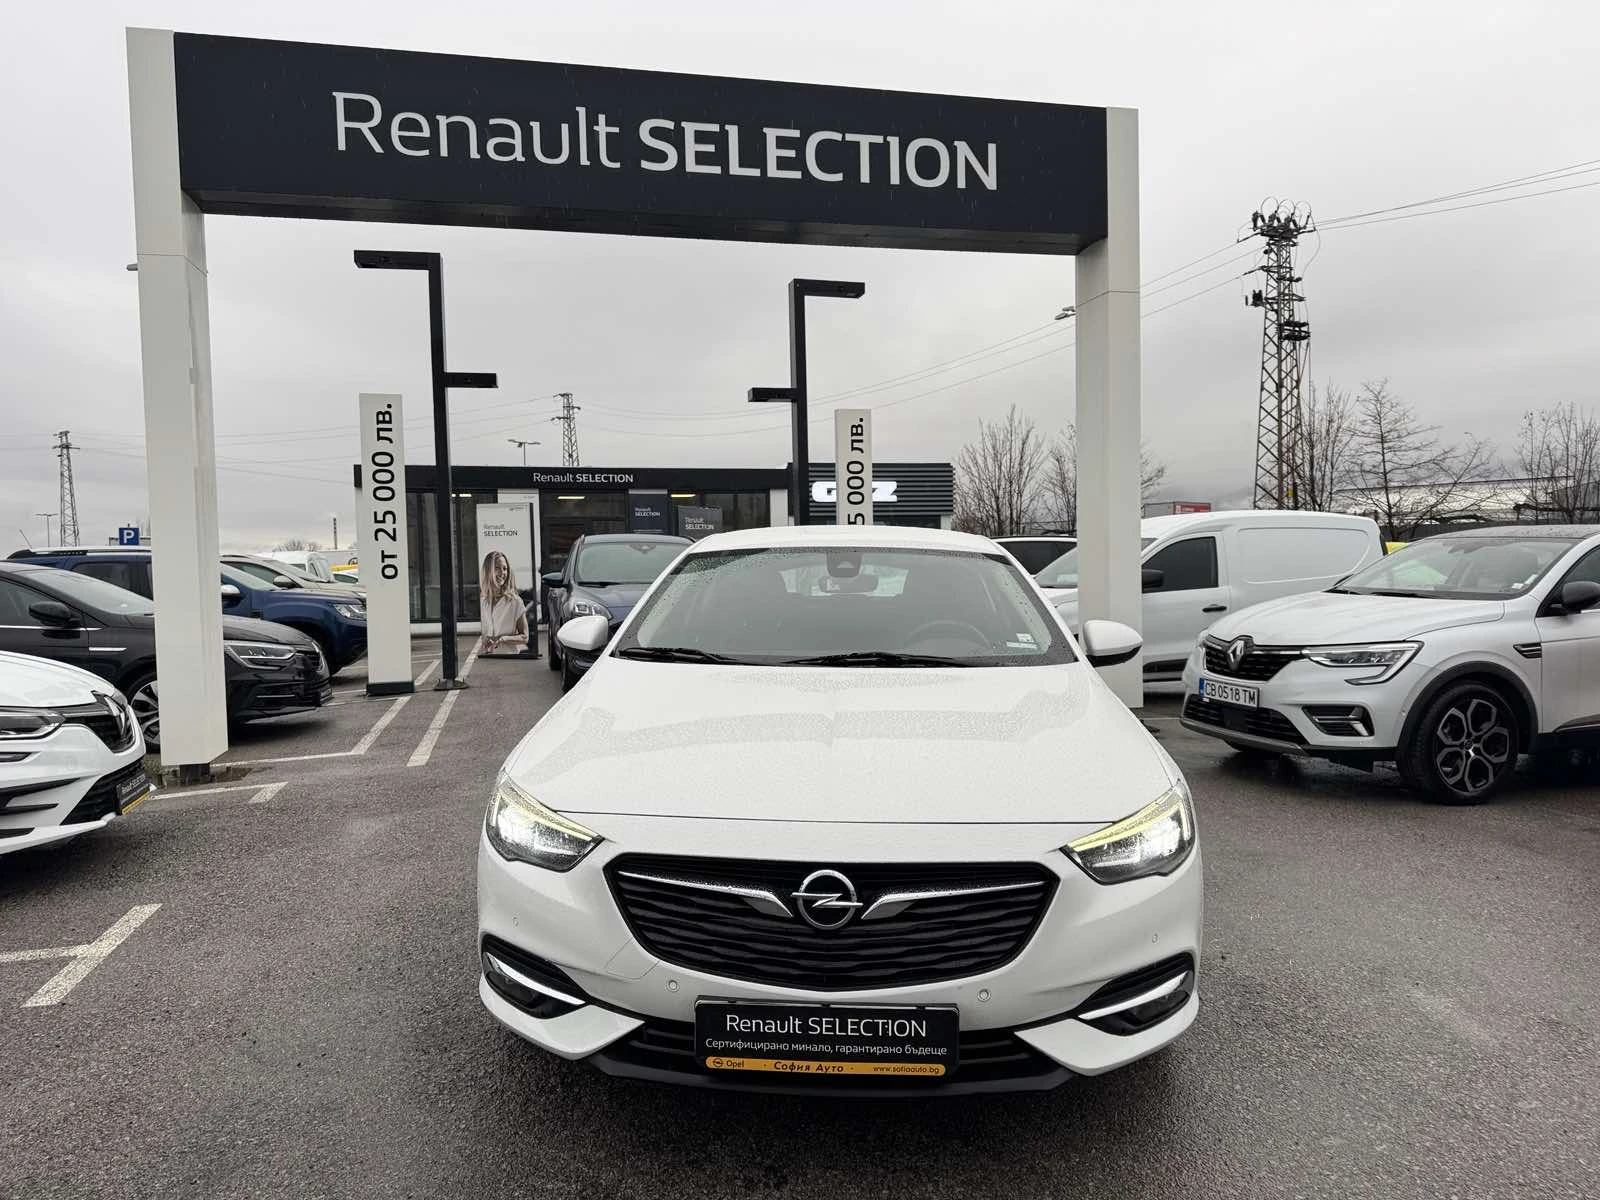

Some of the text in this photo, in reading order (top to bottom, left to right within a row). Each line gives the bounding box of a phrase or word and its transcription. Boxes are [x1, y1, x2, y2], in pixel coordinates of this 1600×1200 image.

[332, 91, 999, 191] Renault SELECTION
[850, 417, 864, 454] лв.
[533, 472, 634, 483] Renault SELECTION
[846, 460, 865, 505] 000
[371, 403, 398, 580] от 25 000 лв.
[123, 530, 135, 544] P
[1205, 682, 1256, 705] CB 0518 TM
[726, 1014, 926, 1037] Renault SELECTION
[705, 1038, 947, 1056] Сертифицирано минало, гарантирано бъдеще
[726, 1060, 745, 1068] Opel
[773, 1061, 844, 1073] София Ауто
